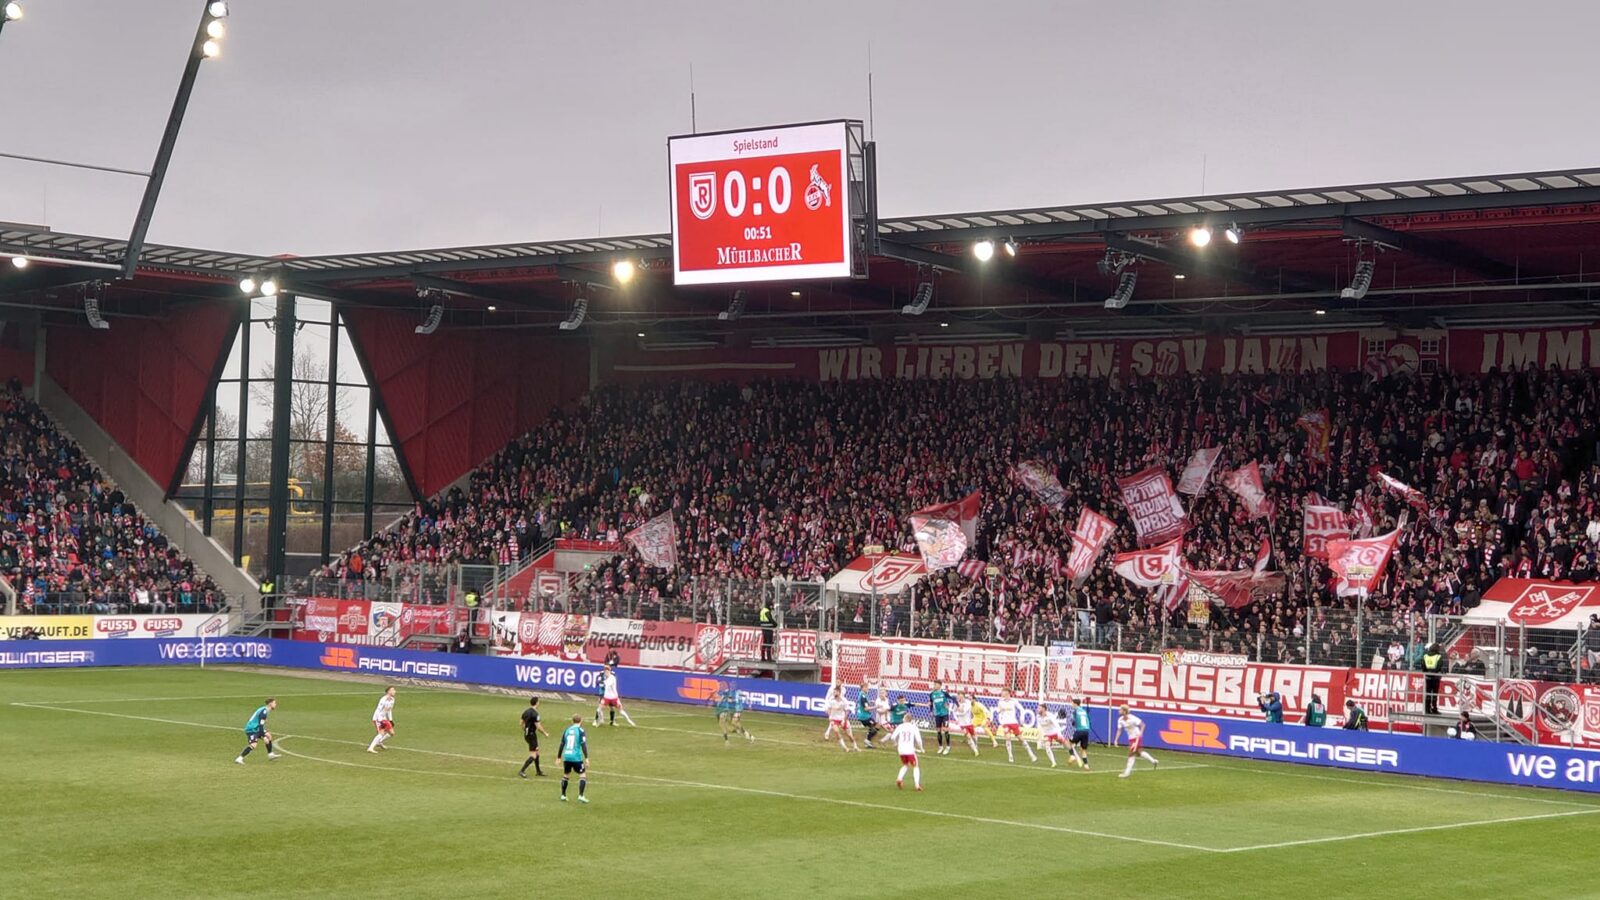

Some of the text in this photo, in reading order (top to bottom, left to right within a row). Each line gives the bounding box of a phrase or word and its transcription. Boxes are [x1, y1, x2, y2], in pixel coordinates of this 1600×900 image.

[733, 137, 778, 154] Spielstand
[744, 226, 772, 240] 00:51
[717, 243, 803, 265] MÜHLBACHER
[818, 347, 882, 381] WIR
[896, 343, 1024, 380] LIEBEN
[1039, 343, 1115, 378] DEN
[1130, 338, 1207, 376] SSV
[100, 620, 135, 630] FUSSL
[146, 619, 180, 630] FUSSL
[159, 643, 188, 658] we
[233, 642, 269, 659] one
[589, 631, 675, 652] REGENSBURG
[677, 636, 692, 652] 81
[359, 657, 457, 677] RÄDLINGER
[515, 664, 541, 683] we
[546, 667, 575, 686] are
[880, 646, 1331, 712] ULTRAS REGENSBURG
[1352, 673, 1407, 700] JAHN
[1229, 735, 1399, 766] RÄDLINGER
[1507, 752, 1557, 779] we
